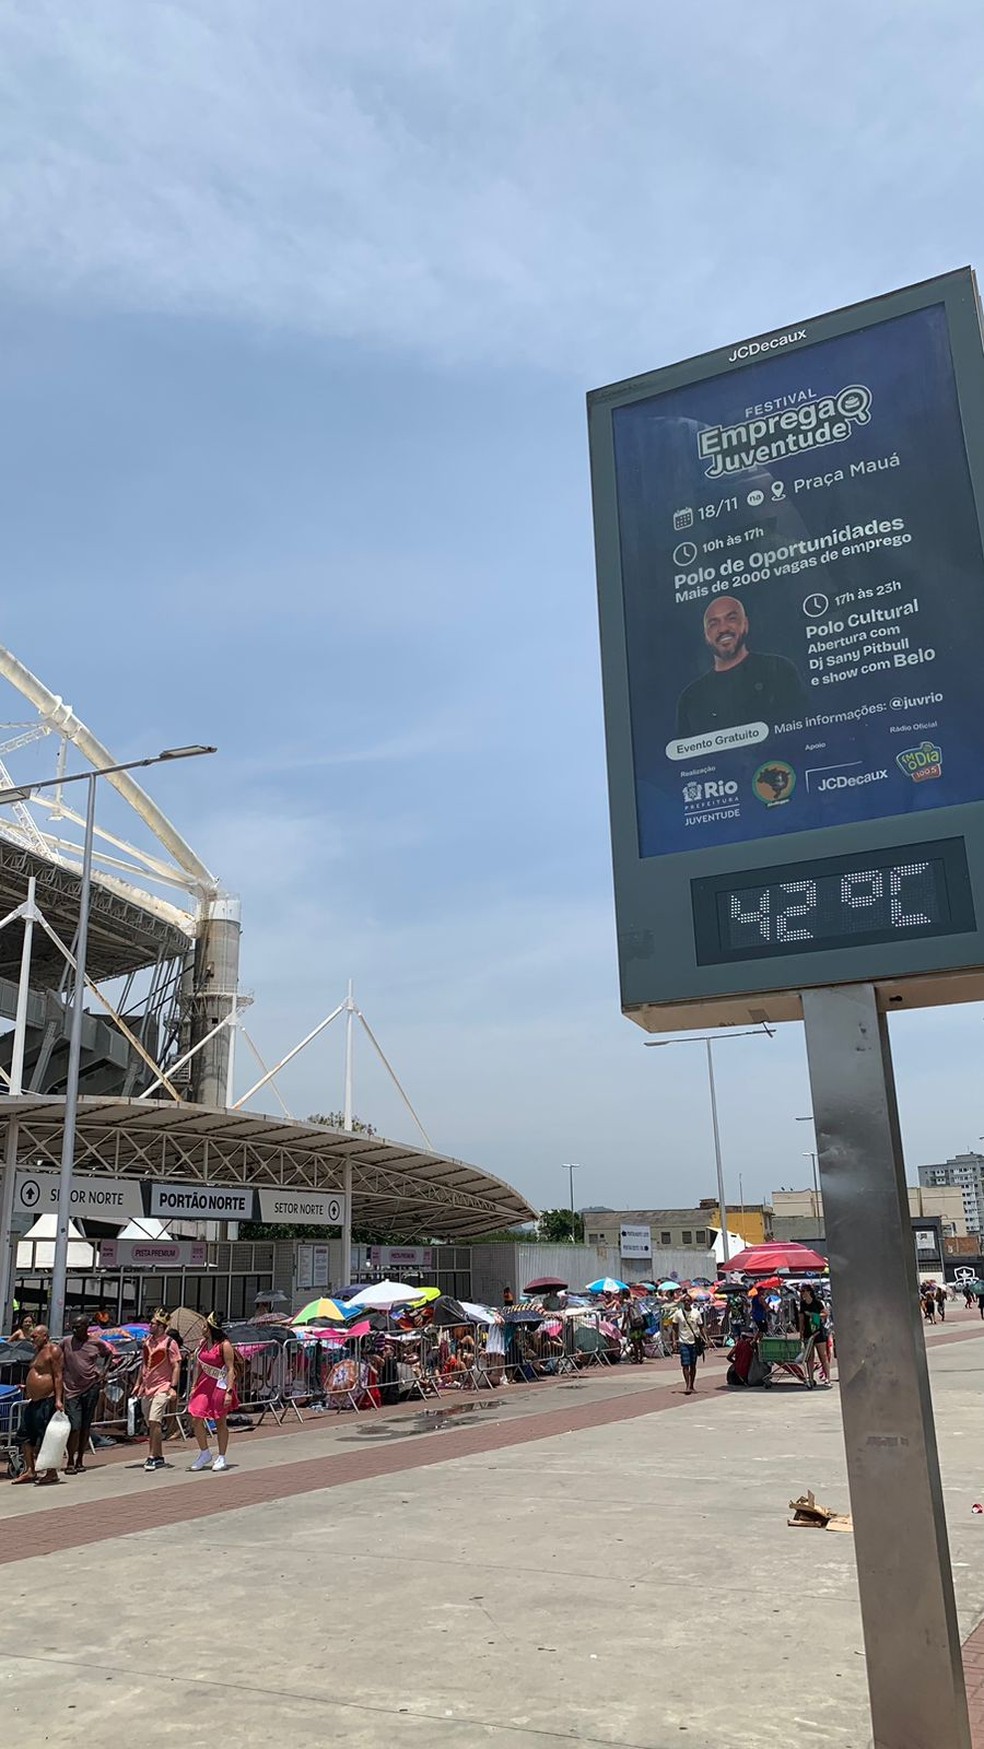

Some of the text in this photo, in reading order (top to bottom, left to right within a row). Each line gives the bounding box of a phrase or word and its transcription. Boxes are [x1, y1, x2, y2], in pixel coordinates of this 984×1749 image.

[728, 328, 807, 362] JCDecaux
[745, 388, 817, 418] FESTIVAL
[701, 400, 835, 454] Emprega
[708, 421, 848, 476] Juventude
[698, 497, 738, 521] 18/11
[794, 471, 844, 494] Praça
[850, 453, 901, 476] Mauá
[674, 517, 905, 589] Polo de Oportunidades
[703, 528, 764, 552] 10h às 17h
[675, 533, 912, 603] Mais de 2000 vagas de emprego
[835, 580, 901, 606] 17h às 23h
[806, 599, 919, 638] Polo Cultural
[808, 625, 900, 654] Abertura com
[809, 638, 910, 672] Dj Sany Pitbull
[811, 647, 936, 686] e show com Belo
[774, 692, 943, 734] Mais informações: @juvrio
[913, 721, 938, 731] Oficial
[676, 728, 760, 754] Evento Gratuito
[805, 741, 826, 751] Apoio
[681, 766, 715, 777] Realização
[817, 769, 888, 793] JCDecaux
[704, 780, 738, 798] Rio
[685, 797, 739, 810] PREFEITURA
[685, 809, 740, 826] JUVENTUDE
[730, 879, 817, 943] 42
[50, 1189, 124, 1205] SOR NORTE
[159, 1192, 246, 1211] PORTÃO NORTE
[274, 1202, 323, 1215] SETOR NORTE
